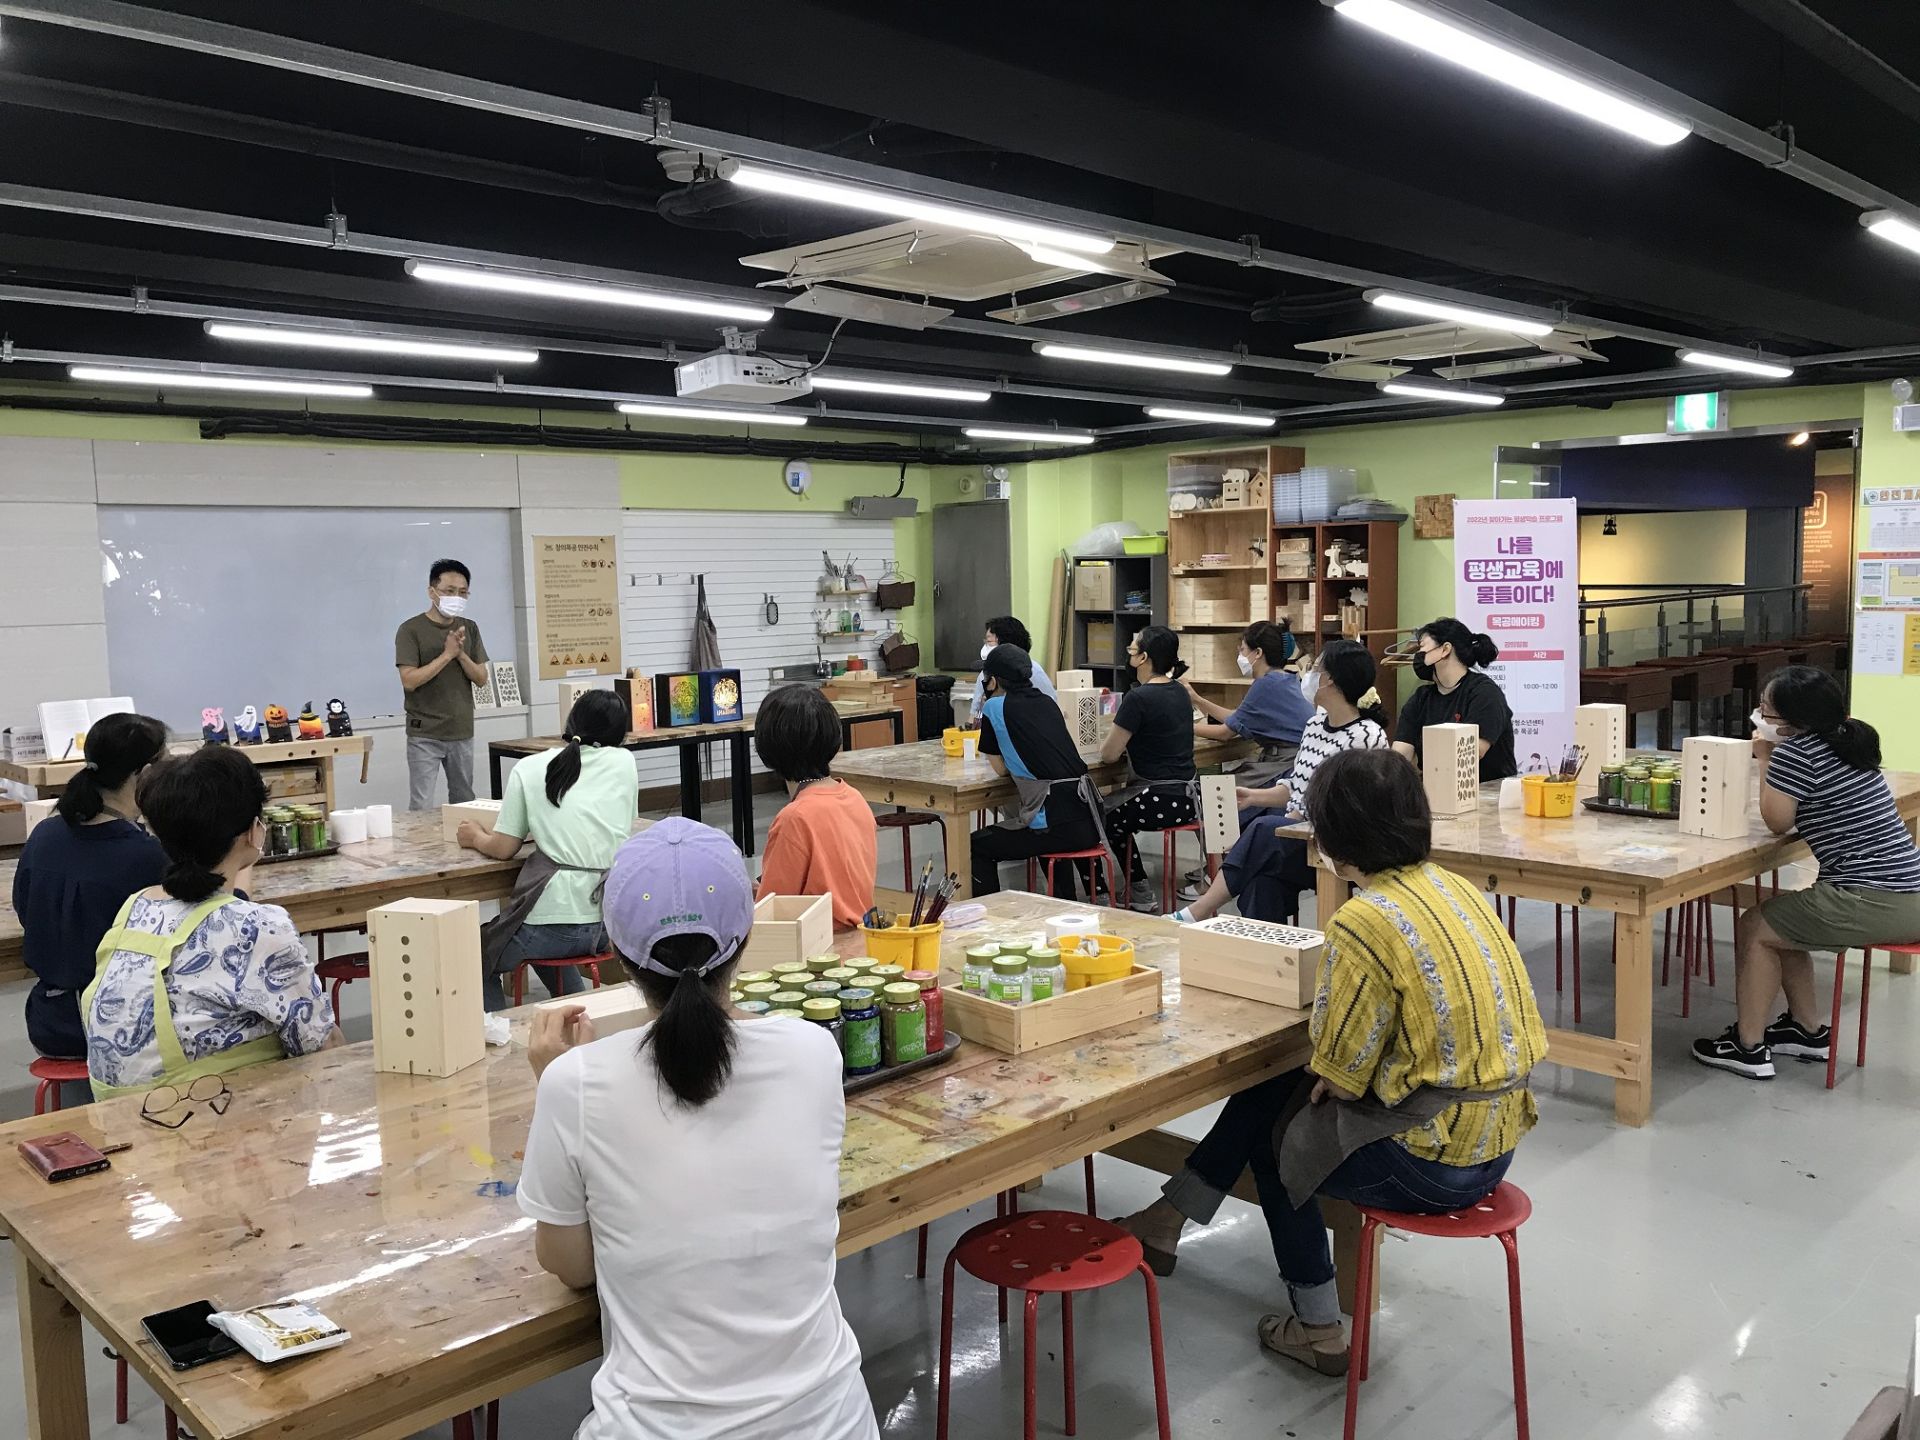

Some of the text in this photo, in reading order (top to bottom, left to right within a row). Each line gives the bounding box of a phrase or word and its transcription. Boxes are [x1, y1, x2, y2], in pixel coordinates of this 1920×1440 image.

[1497, 536, 1533, 555] 나를
[1467, 560, 1563, 580] 평생교육에
[1477, 585, 1554, 604] 물들이다!
